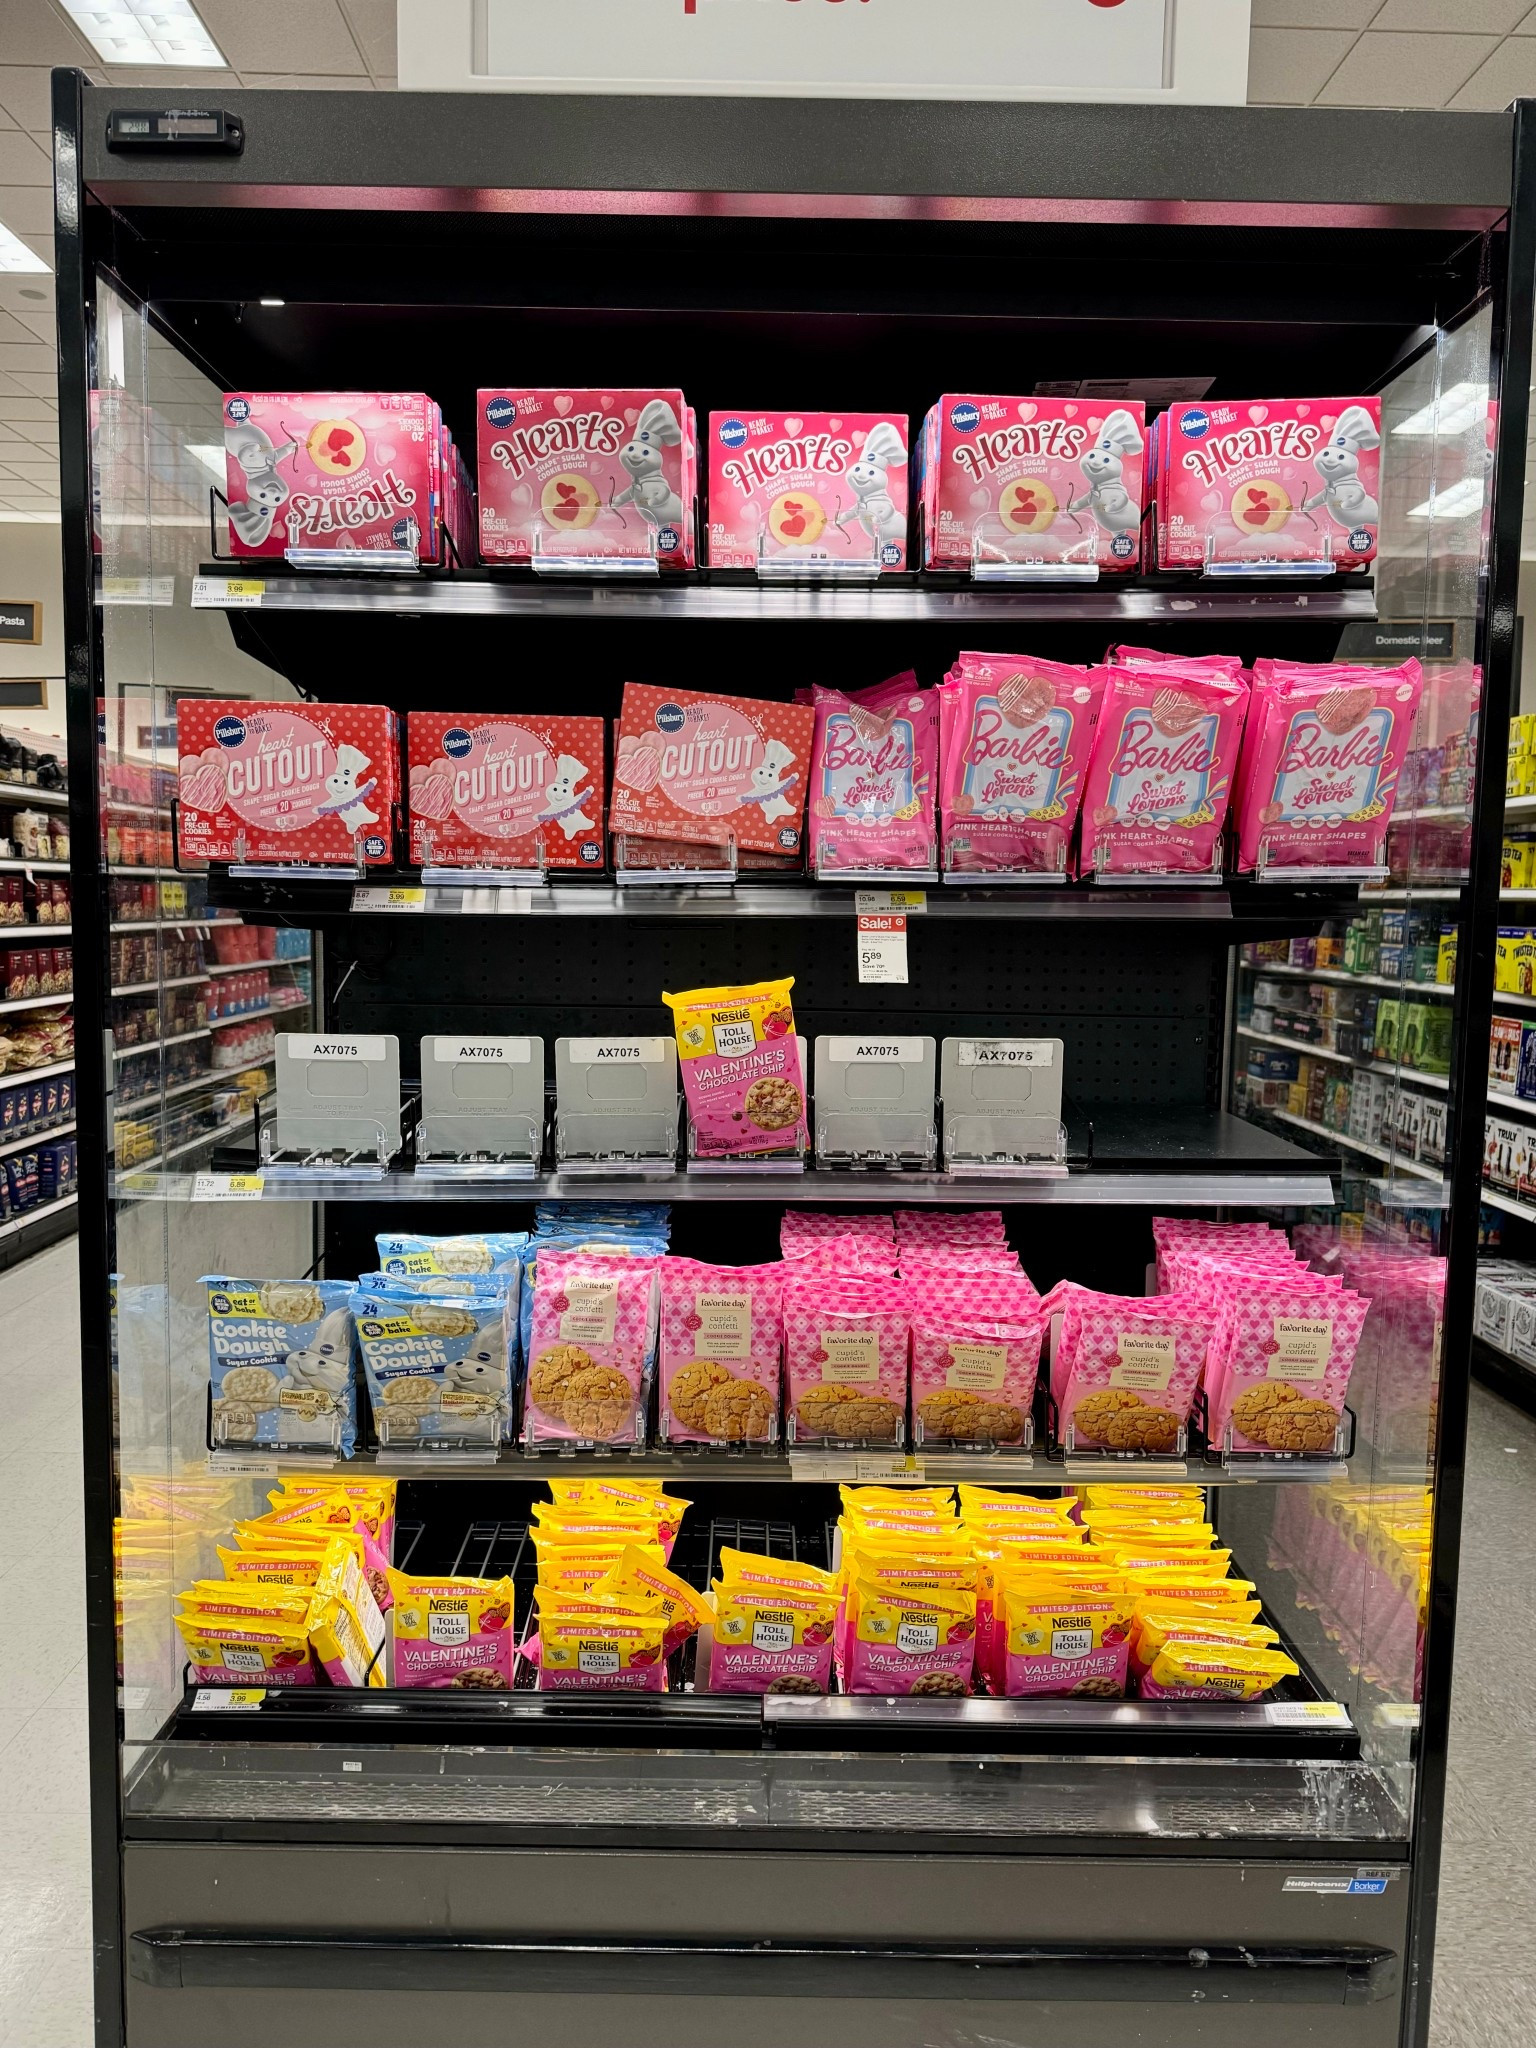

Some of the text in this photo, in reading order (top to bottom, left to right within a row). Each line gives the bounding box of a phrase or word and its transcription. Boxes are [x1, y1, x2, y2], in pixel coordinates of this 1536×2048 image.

[517, 396, 535, 407] READY
[486, 406, 515, 420] Pillsbury
[951, 411, 980, 424] Pillsbury
[1211, 407, 1230, 418] READY
[1180, 416, 1210, 431] Pillsbury
[719, 427, 748, 440] Pillsbury
[491, 412, 624, 480] Hearts
[953, 419, 1087, 484] Hearts
[562, 454, 585, 463] SUGAR
[1182, 420, 1320, 489] Hearts
[722, 434, 853, 498] Hearts
[1254, 460, 1279, 469] SUGAR
[538, 461, 588, 481] COOKIE DOUGH
[1228, 467, 1281, 488] COOKIE DOUGH
[766, 480, 815, 499] COOKIE DOUGH
[285, 469, 416, 534] Hearts
[482, 508, 495, 518] 20
[940, 511, 953, 521] 20
[1171, 516, 1183, 525] 20
[712, 524, 724, 533] 20
[194, 584, 207, 592] 7.01
[227, 585, 243, 593] 3.99
[0, 615, 25, 626] Pasta
[1376, 636, 1420, 645] Domestic
[247, 717, 265, 728] READY
[657, 712, 684, 724] Pillsbury
[215, 726, 245, 738] Pillsbury
[693, 718, 729, 741] heart
[257, 727, 294, 754] heart
[444, 737, 472, 750] Pillsbury
[970, 710, 1073, 769] Barbie
[483, 738, 518, 764] heart
[822, 724, 920, 775] Barbie
[1116, 721, 1221, 777] Barbie
[1277, 723, 1393, 774] Barbie
[661, 734, 758, 780] CUTOUT
[228, 740, 328, 798] CUTOUT
[455, 751, 548, 806] CUTOUT
[994, 769, 1038, 785] Sweet
[856, 777, 891, 794] Sweet
[1142, 780, 1186, 799] Sweet
[1311, 775, 1356, 793] Sweet
[618, 790, 630, 799] 20
[184, 812, 198, 822] 20
[414, 820, 426, 829] 20
[821, 829, 916, 838] PINK HEART SHAPES
[1327, 832, 1366, 840] SHAPES
[860, 917, 892, 930] Sale!
[711, 1009, 750, 1024] Nestlé
[722, 1026, 746, 1037] TOLL
[718, 1035, 752, 1048] HOUSE
[314, 1045, 358, 1055] AX7075
[459, 1047, 503, 1058] AX7075
[597, 1047, 640, 1058] AX7075
[856, 1046, 899, 1056] AX7075
[979, 1051, 1033, 1061] AX7075
[694, 1050, 785, 1083] VALENTINE'S
[699, 1063, 785, 1092] CHOCOLATE CHIP
[1498, 1128, 1518, 1142] TRULY
[389, 1242, 403, 1251] 24
[362, 1304, 378, 1314] 24
[701, 1298, 747, 1308] favorite day
[235, 1306, 256, 1314] bake
[211, 1320, 287, 1339] Cookie
[388, 1326, 411, 1334] bake
[1280, 1322, 1328, 1335] favorite day
[214, 1337, 291, 1356] Dough
[364, 1337, 444, 1356] Cookie
[826, 1336, 873, 1346] favorite day
[1124, 1339, 1170, 1351] favorite day
[226, 1356, 278, 1367] Sugar Cookie
[370, 1351, 448, 1371] Dough
[385, 1367, 435, 1378] Sugar Cookie
[241, 1562, 312, 1571] LIMITED EDITION
[746, 1573, 819, 1591] LIMITED EDITION
[1033, 1604, 1109, 1614] LIMITED EDITION
[437, 1617, 461, 1626] TOLL
[432, 1626, 467, 1635] HOUSE
[762, 1625, 786, 1635] TOLL
[907, 1627, 930, 1638] TOLL
[756, 1633, 790, 1643] HOUSE
[900, 1634, 935, 1646] HOUSE
[1061, 1634, 1085, 1643] TOLL
[1055, 1642, 1089, 1650] HOUSE
[231, 1653, 254, 1662] TOLL
[404, 1643, 498, 1663] VALENTINE'S
[587, 1654, 612, 1662] TOLL
[868, 1651, 962, 1666] VALENTINE'S
[227, 1658, 261, 1667] HOUSE
[407, 1655, 496, 1671] CHOCOLATE CHIP
[582, 1660, 617, 1668] HOUSE
[724, 1654, 818, 1665] VALENTINE'S
[1023, 1655, 1118, 1675] VALENTINE'S
[726, 1664, 815, 1674] CHOCOLATE CHIP
[1025, 1665, 1116, 1683] CHOCOLATE CHIP
[202, 1671, 296, 1683] VALENTINE'S
[552, 1673, 648, 1686] VALENTINE'S
[1354, 1882, 1381, 1891] Barker
